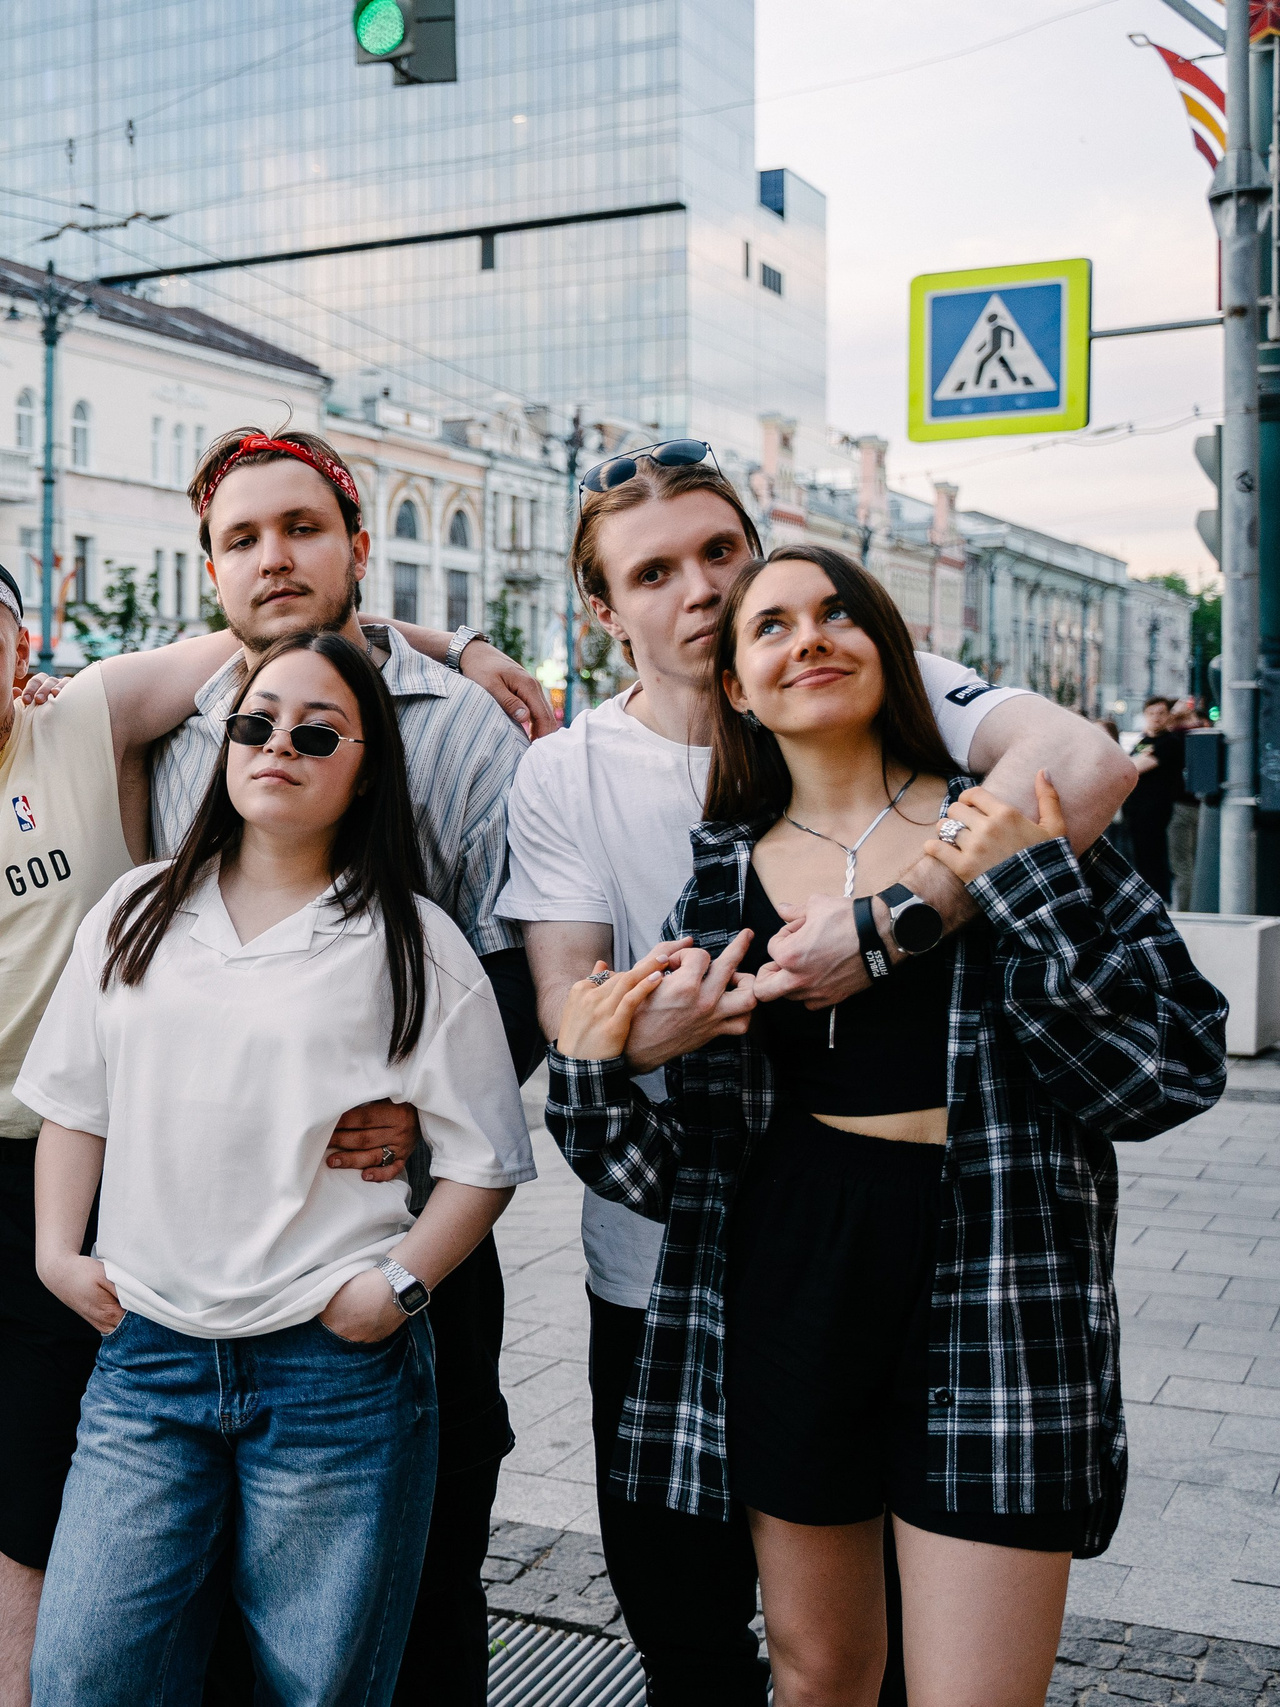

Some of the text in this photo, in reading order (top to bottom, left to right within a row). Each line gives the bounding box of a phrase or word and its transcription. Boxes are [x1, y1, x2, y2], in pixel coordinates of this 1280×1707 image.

[5, 848, 72, 897] GOD
[865, 950, 881, 978] PUBLICA
[873, 950, 889, 976] FITNESS
